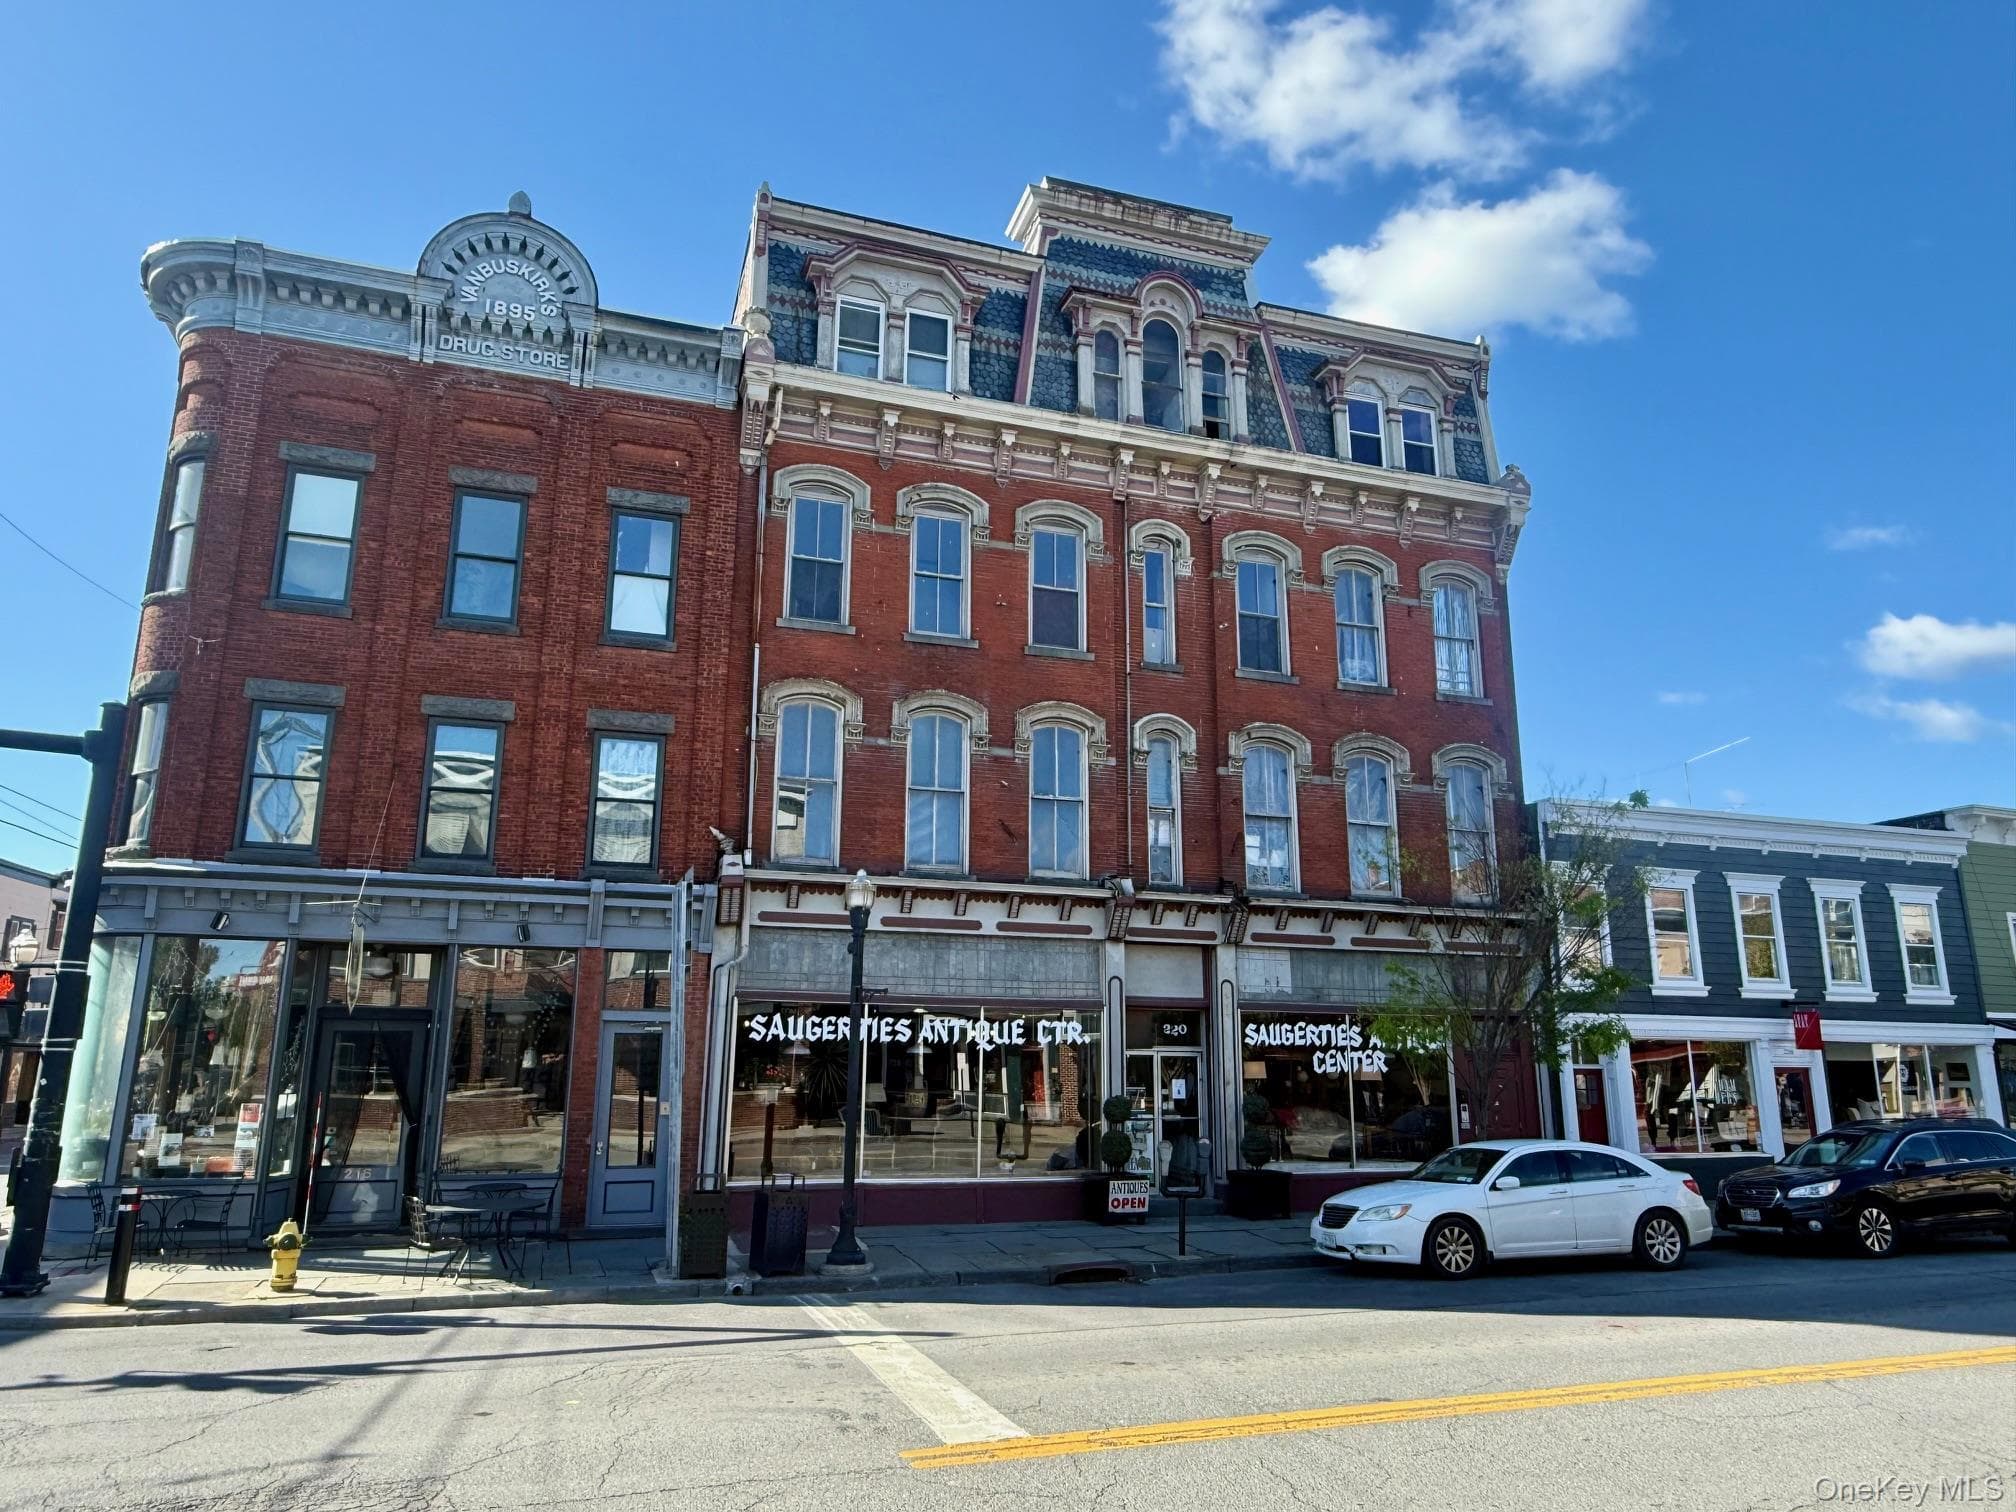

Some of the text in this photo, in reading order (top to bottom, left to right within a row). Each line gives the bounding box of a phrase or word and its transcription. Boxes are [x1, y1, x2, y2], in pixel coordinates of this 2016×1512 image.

[485, 298, 536, 321] 1895
[439, 334, 569, 369] DRUG STORE
[749, 1012, 1091, 1051] SAUGERTIES ANTIQUE CTR.
[1163, 1023, 1188, 1036] 220
[1244, 1022, 1364, 1049] SAUGERTIES
[1312, 1049, 1389, 1075] CENTER
[1110, 1181, 1149, 1195] ANTIQUES
[1110, 1197, 1146, 1210] OPEN
